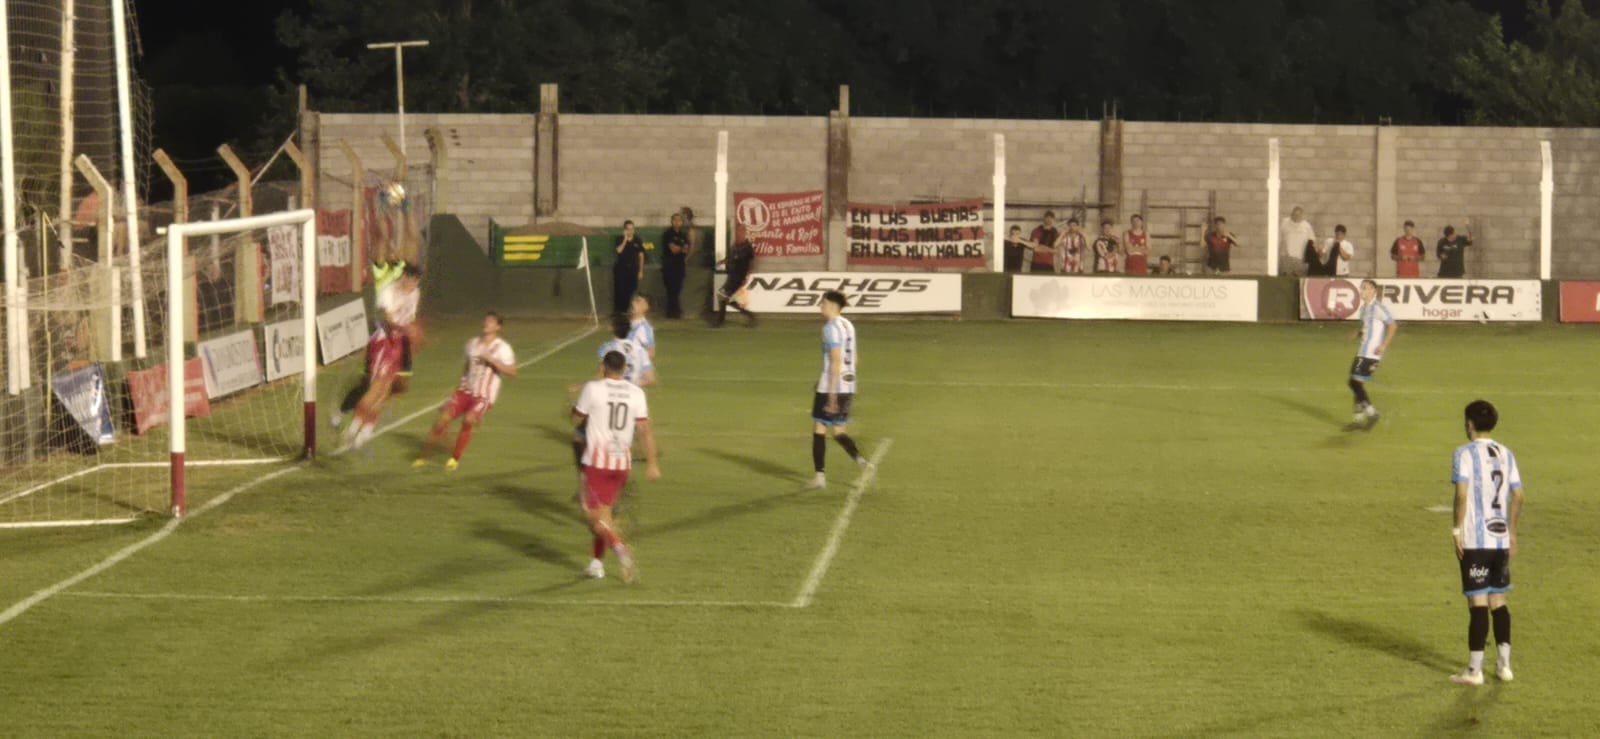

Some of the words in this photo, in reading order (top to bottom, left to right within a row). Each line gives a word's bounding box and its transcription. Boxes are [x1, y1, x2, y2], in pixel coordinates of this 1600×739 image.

[851, 208, 871, 223] EN
[879, 210, 909, 225] LAS
[919, 206, 979, 224] BUENAS
[786, 227, 796, 241] el
[851, 225, 871, 241] EN
[879, 228, 910, 242] LAS
[916, 226, 963, 241] MALAS
[970, 226, 980, 240] Y
[786, 243, 821, 255] Familia
[851, 243, 871, 258] EN
[874, 243, 902, 257] LAS
[906, 244, 934, 260] MUY
[746, 277, 931, 293] NACHOS
[1091, 284, 1123, 298] LAS
[1129, 284, 1229, 300] MAGNOLIAS
[1375, 285, 1515, 305] RIVERA
[1422, 306, 1463, 320] hogar
[607, 401, 628, 430] 10
[1491, 470, 1504, 510] 2
